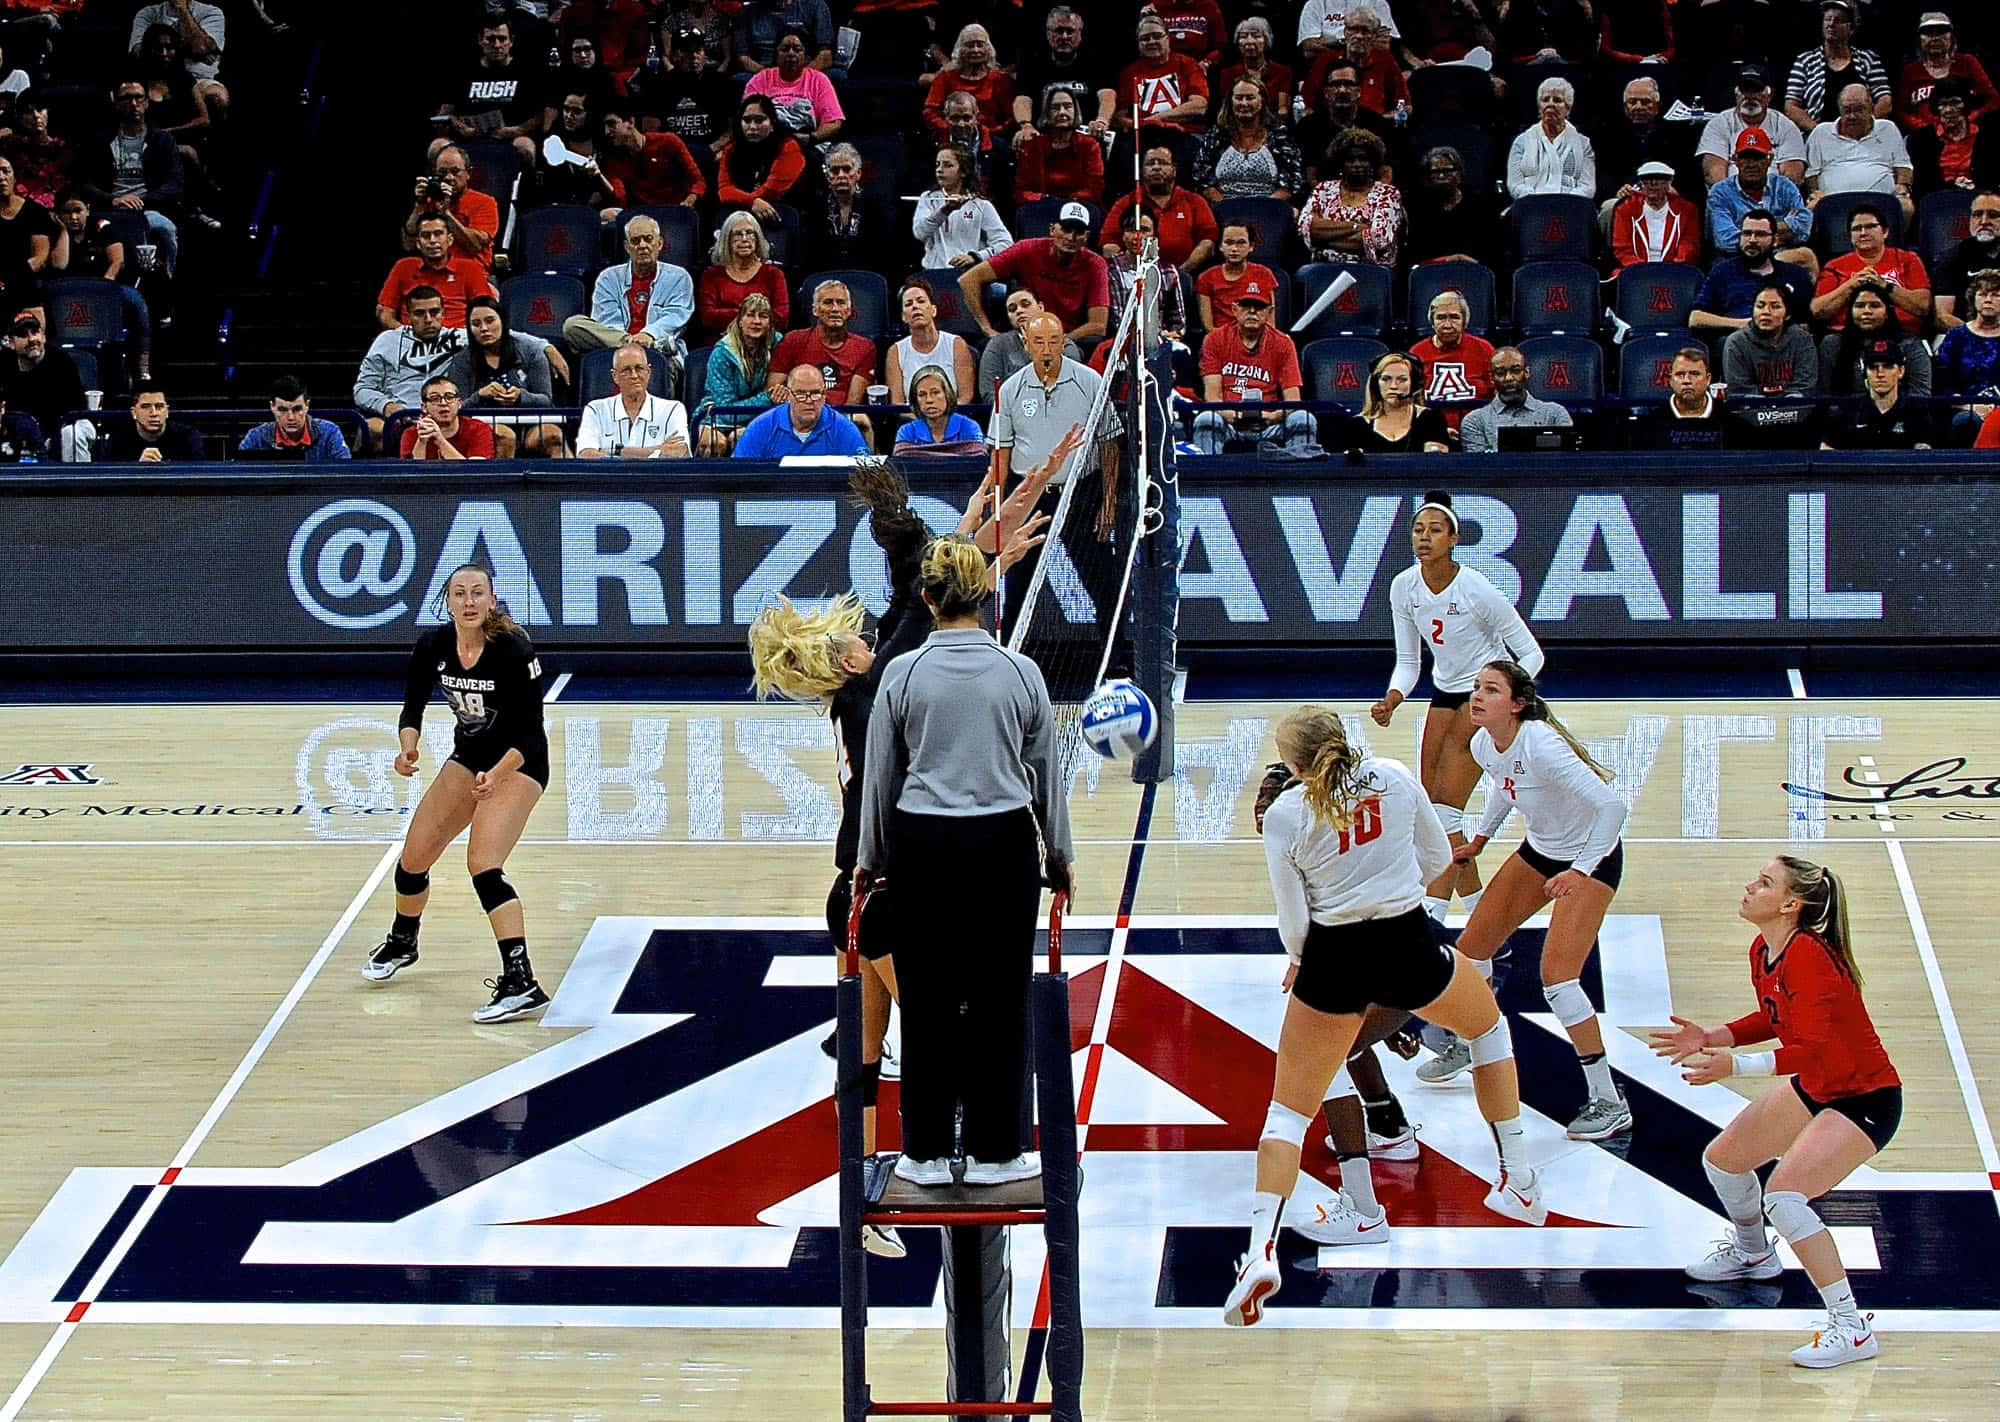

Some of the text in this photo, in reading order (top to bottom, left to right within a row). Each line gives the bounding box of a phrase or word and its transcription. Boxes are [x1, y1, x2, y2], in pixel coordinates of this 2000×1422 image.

[468, 80, 519, 99] RUSH
[666, 113, 710, 128] SWEET
[1431, 618, 1445, 646] 2
[526, 656, 543, 680] 18
[441, 674, 496, 692] BEAVERS
[452, 691, 487, 718] 18
[81, 804, 303, 816] Medical
